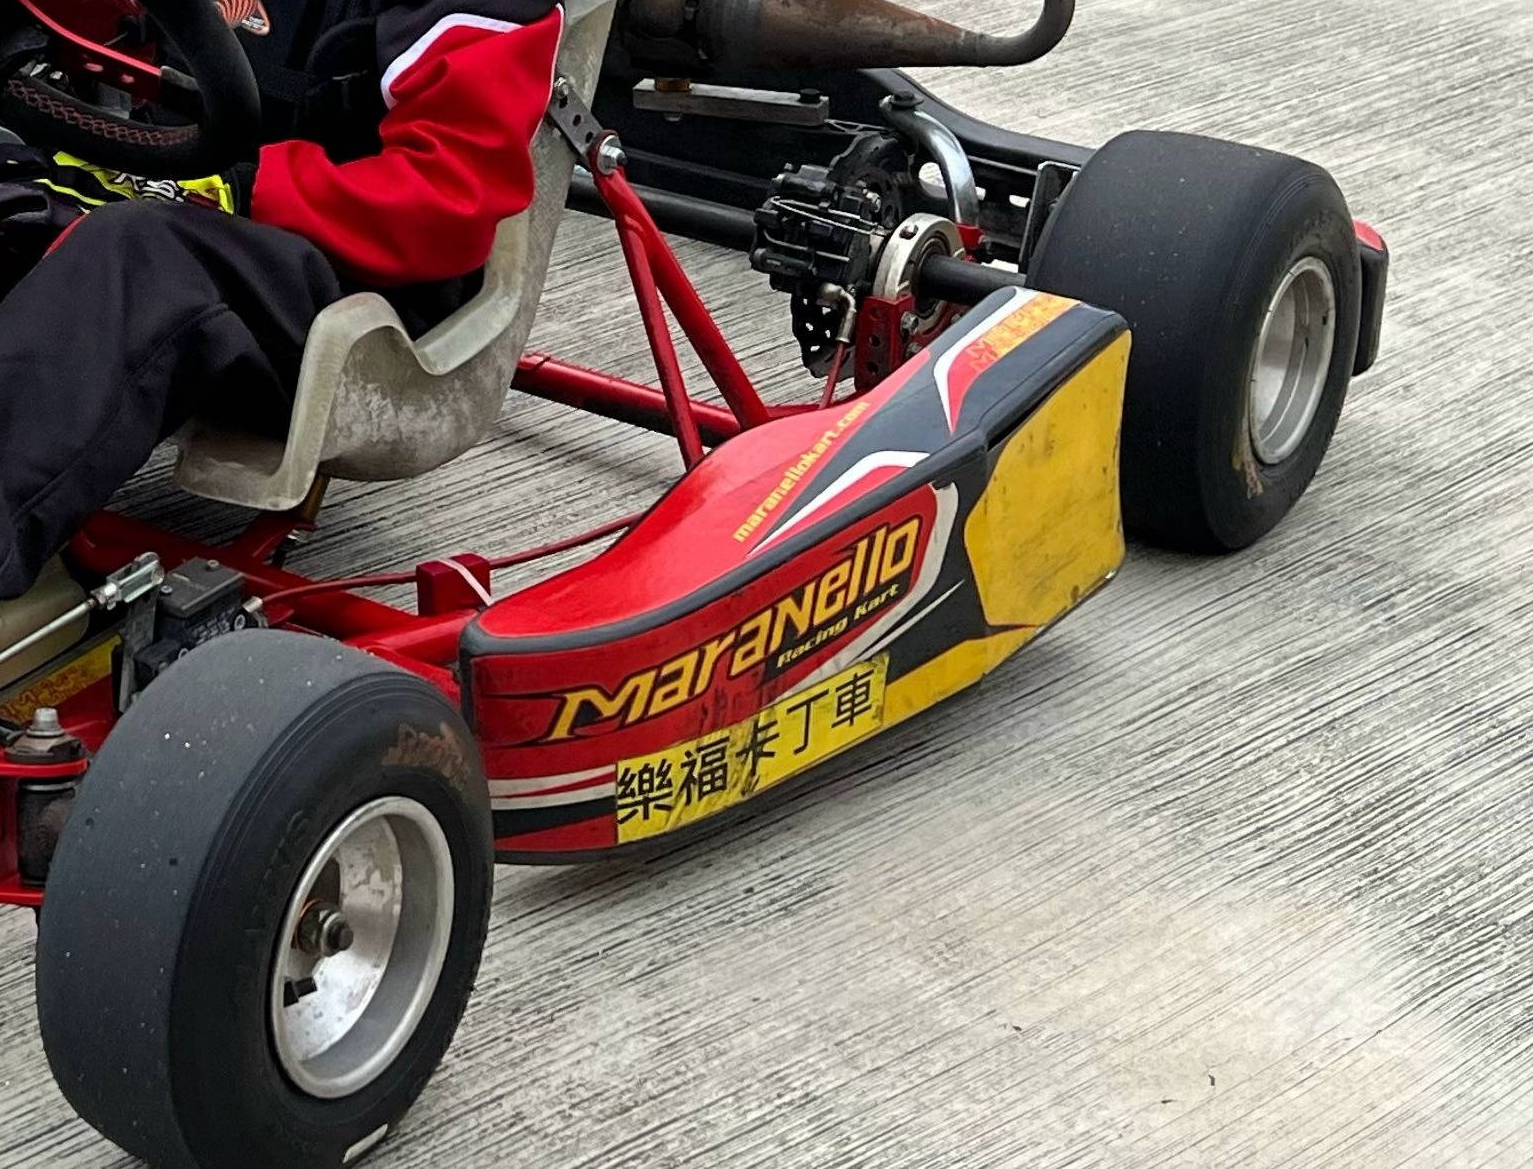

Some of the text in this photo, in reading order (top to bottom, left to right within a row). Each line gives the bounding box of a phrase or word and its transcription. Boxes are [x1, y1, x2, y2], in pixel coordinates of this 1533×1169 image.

[733, 401, 871, 542] maranellokart.com
[776, 583, 899, 669] Racing Kart
[617, 669, 875, 824] 樂福卡丁車
